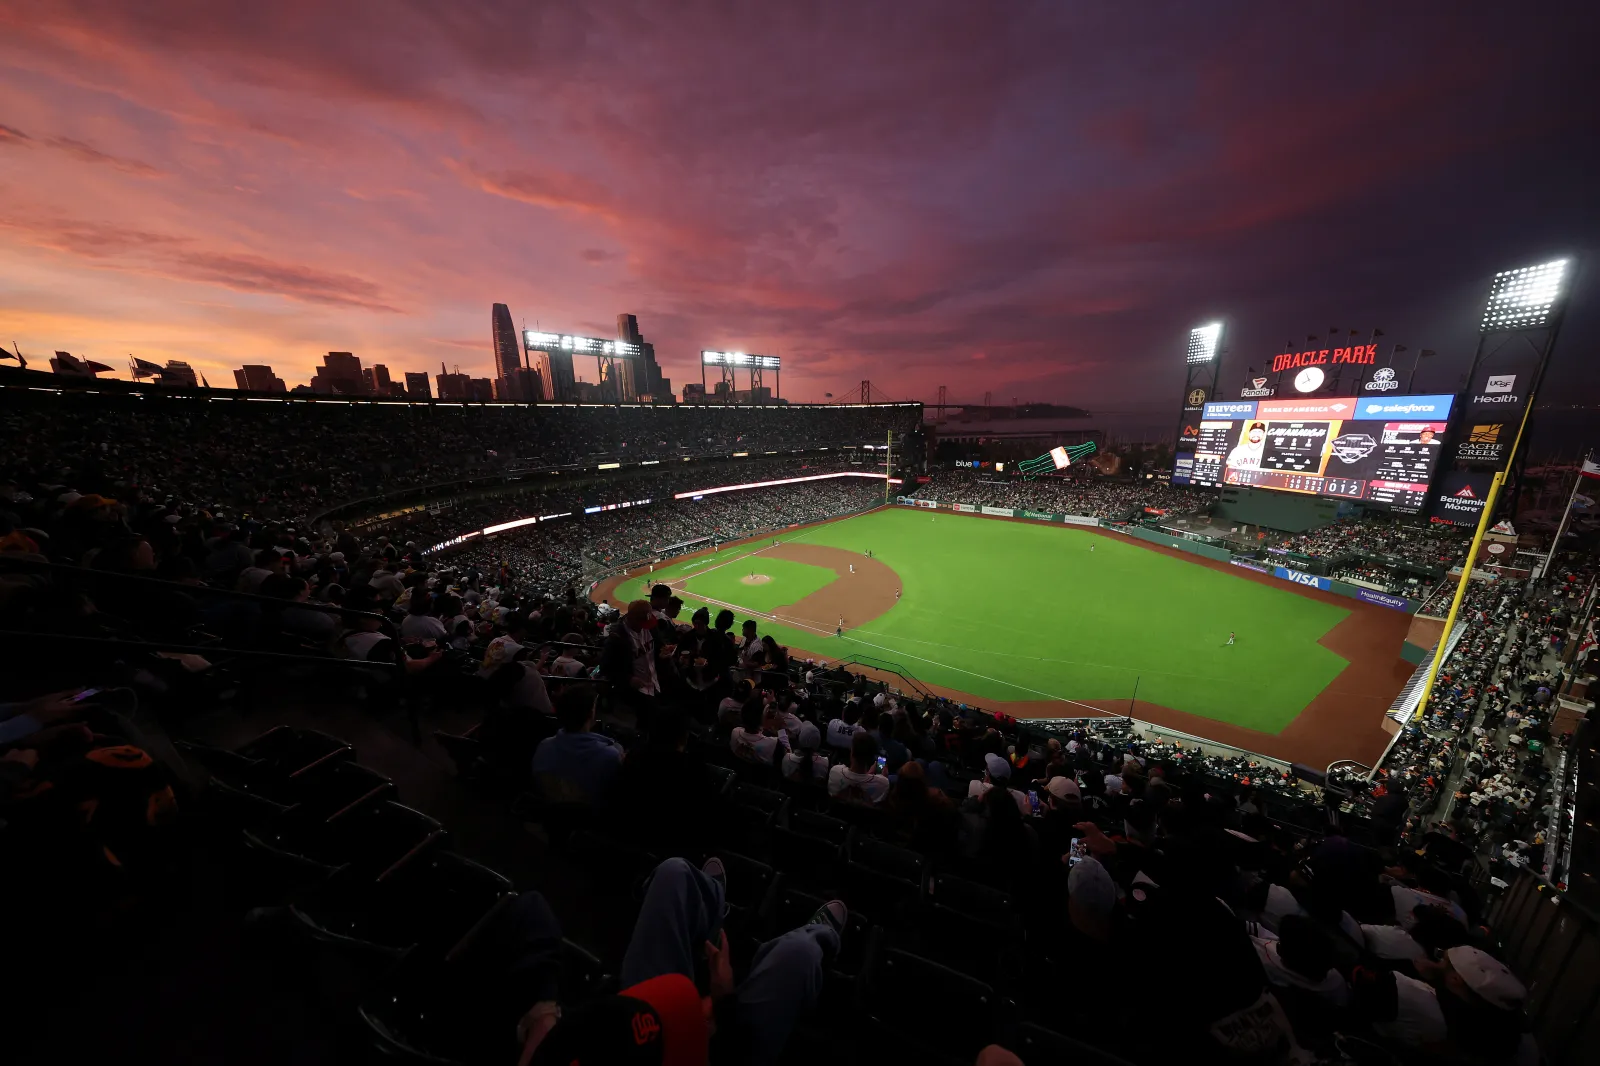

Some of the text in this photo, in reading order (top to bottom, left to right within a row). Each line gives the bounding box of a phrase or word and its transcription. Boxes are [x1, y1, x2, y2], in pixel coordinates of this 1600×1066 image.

[1272, 344, 1378, 372] ORACLE PARK
[1365, 380, 1398, 391] coupa
[1490, 380, 1512, 388] UCSF
[1474, 394, 1518, 403] Health
[1208, 403, 1252, 412] nuveen
[1383, 404, 1435, 413] salesforce
[1329, 483, 1336, 492] 0
[1348, 485, 1357, 494] 2
[1440, 495, 1486, 507] Benjamin
[1444, 502, 1478, 512] Moore
[1286, 569, 1319, 588] VISA
[1360, 590, 1403, 606] HealthEquity
